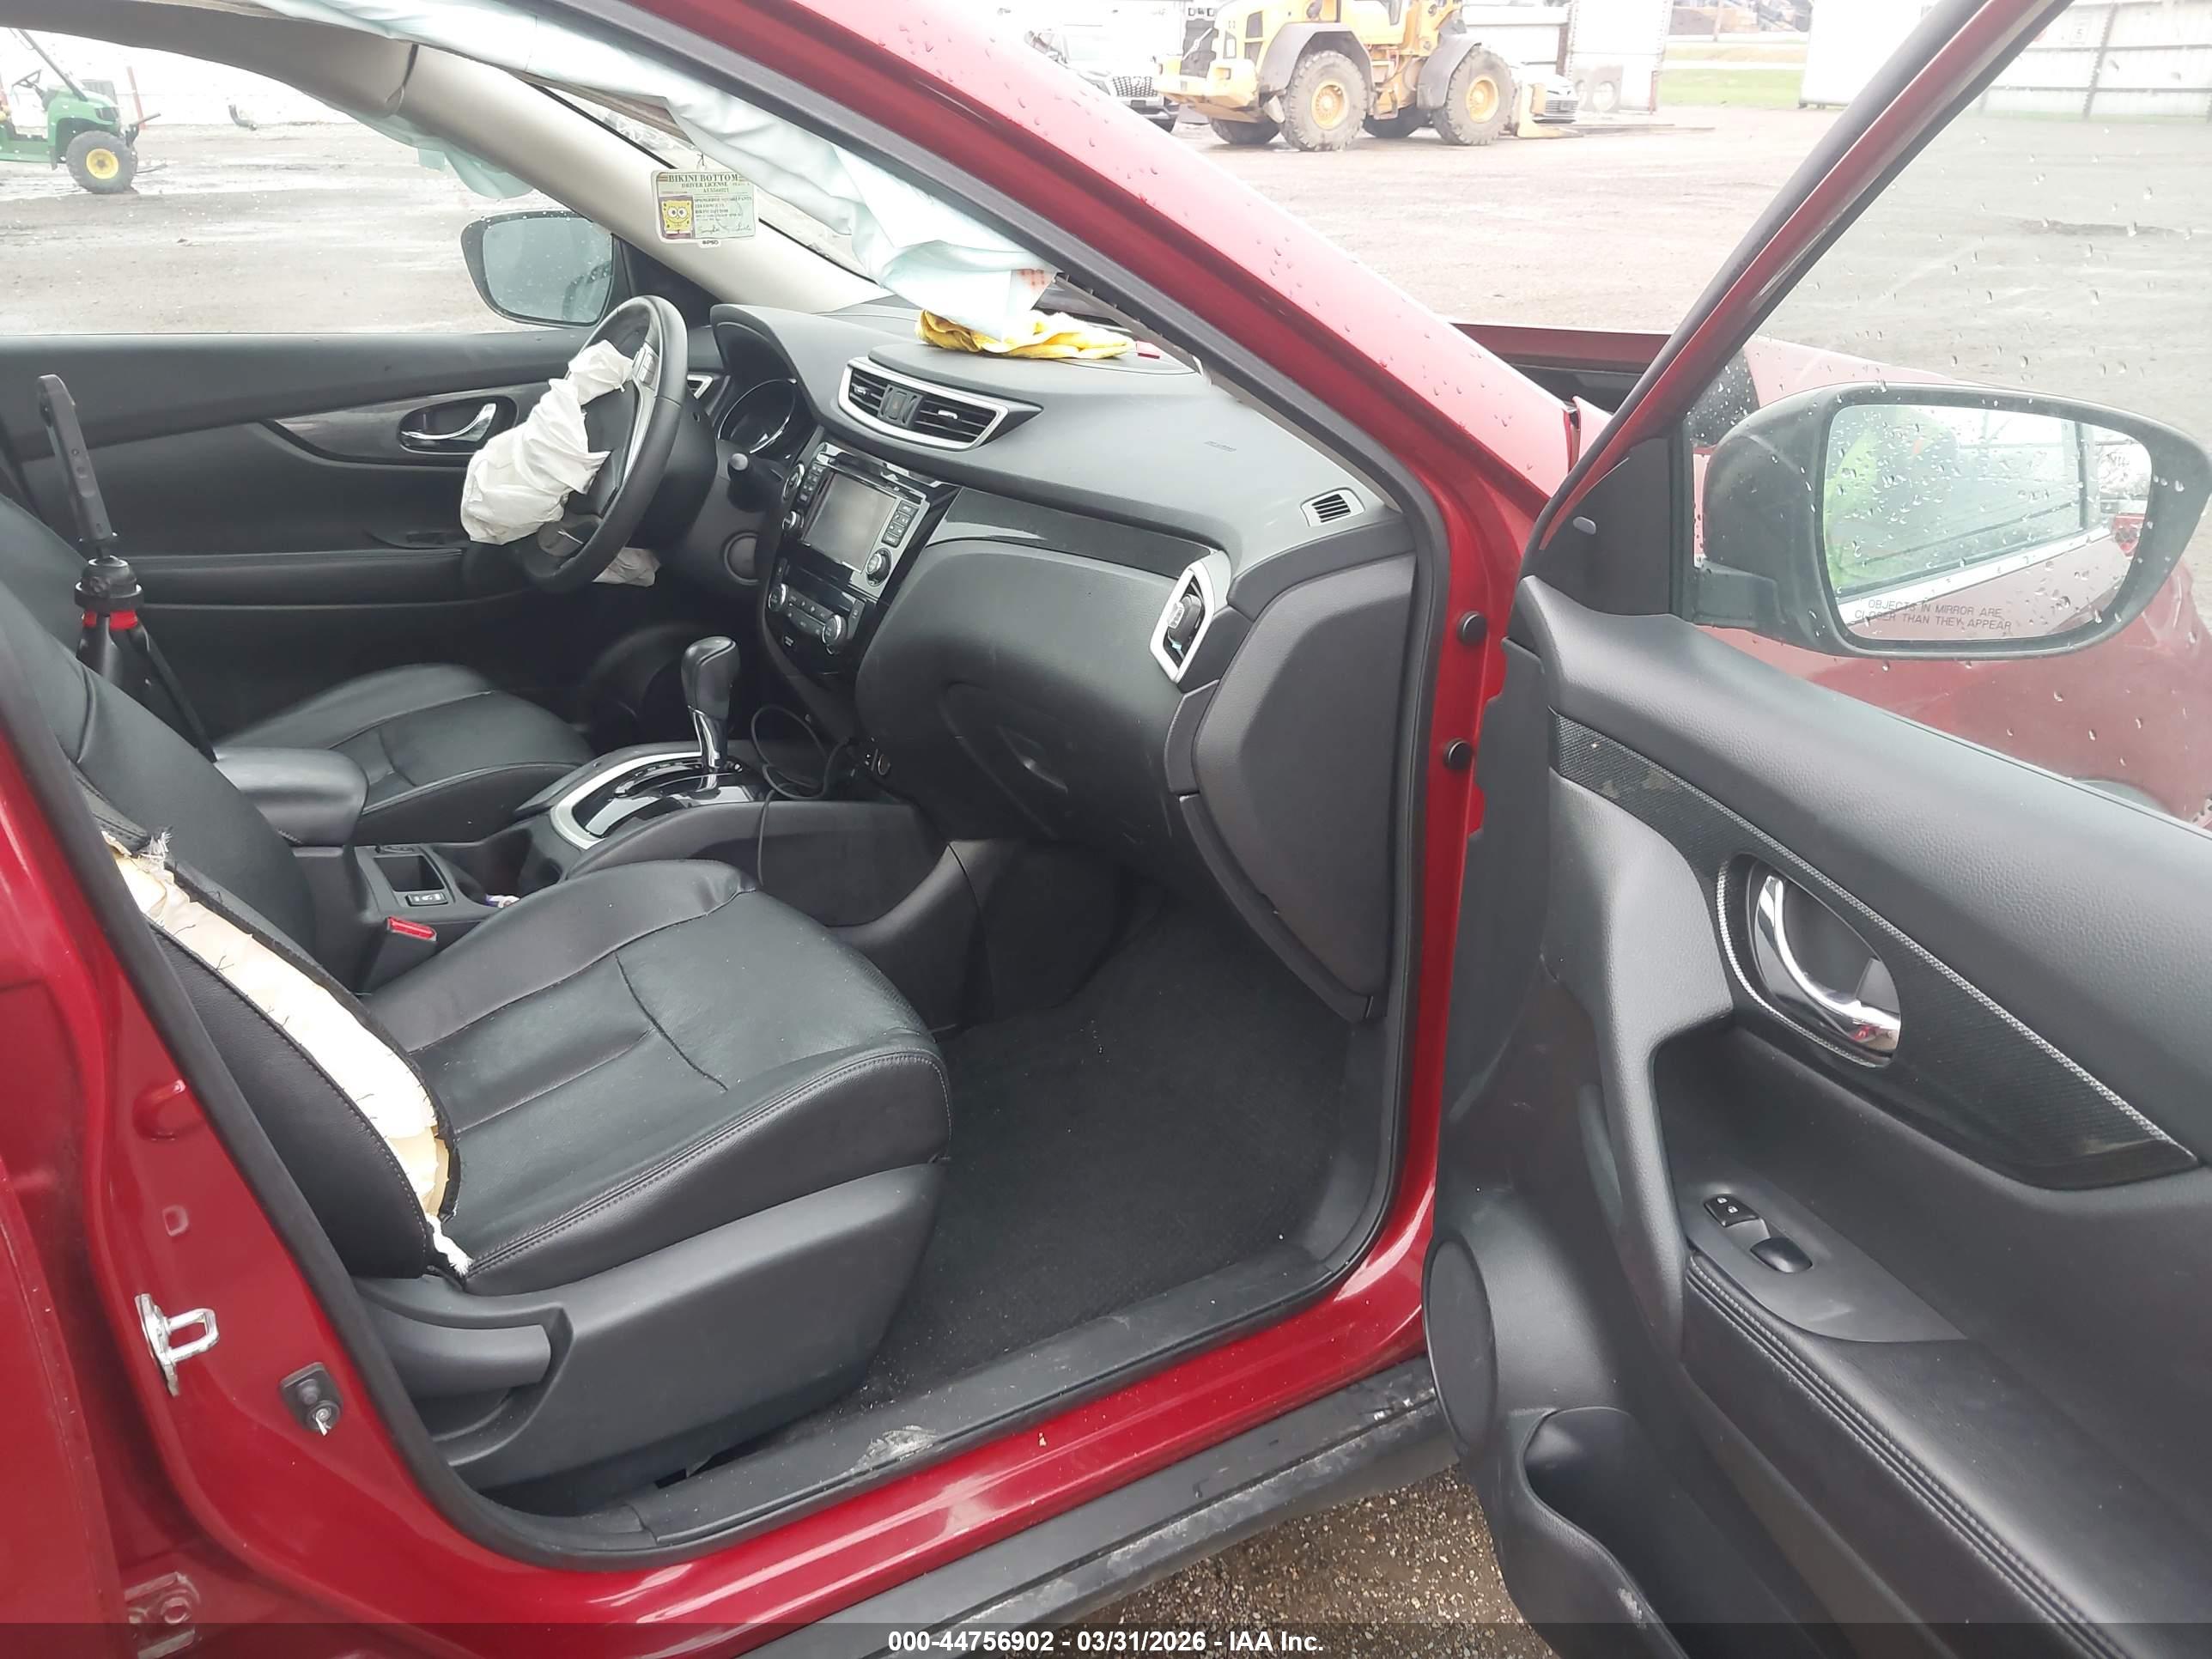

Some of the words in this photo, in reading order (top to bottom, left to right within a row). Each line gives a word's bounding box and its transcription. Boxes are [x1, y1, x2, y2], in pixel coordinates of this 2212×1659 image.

[669, 174, 698, 183] BIKINI
[700, 173, 738, 182] BOTTOM
[1868, 599, 1916, 612] OBJECTS
[1920, 603, 1931, 613] IN
[1935, 604, 1974, 616] MIRROR
[1978, 606, 2002, 617] ARE
[1854, 609, 1896, 622] CLOSER
[1902, 614, 1930, 624] THAN
[1936, 616, 1963, 627] THEY
[1966, 618, 2012, 630] APPEAR
